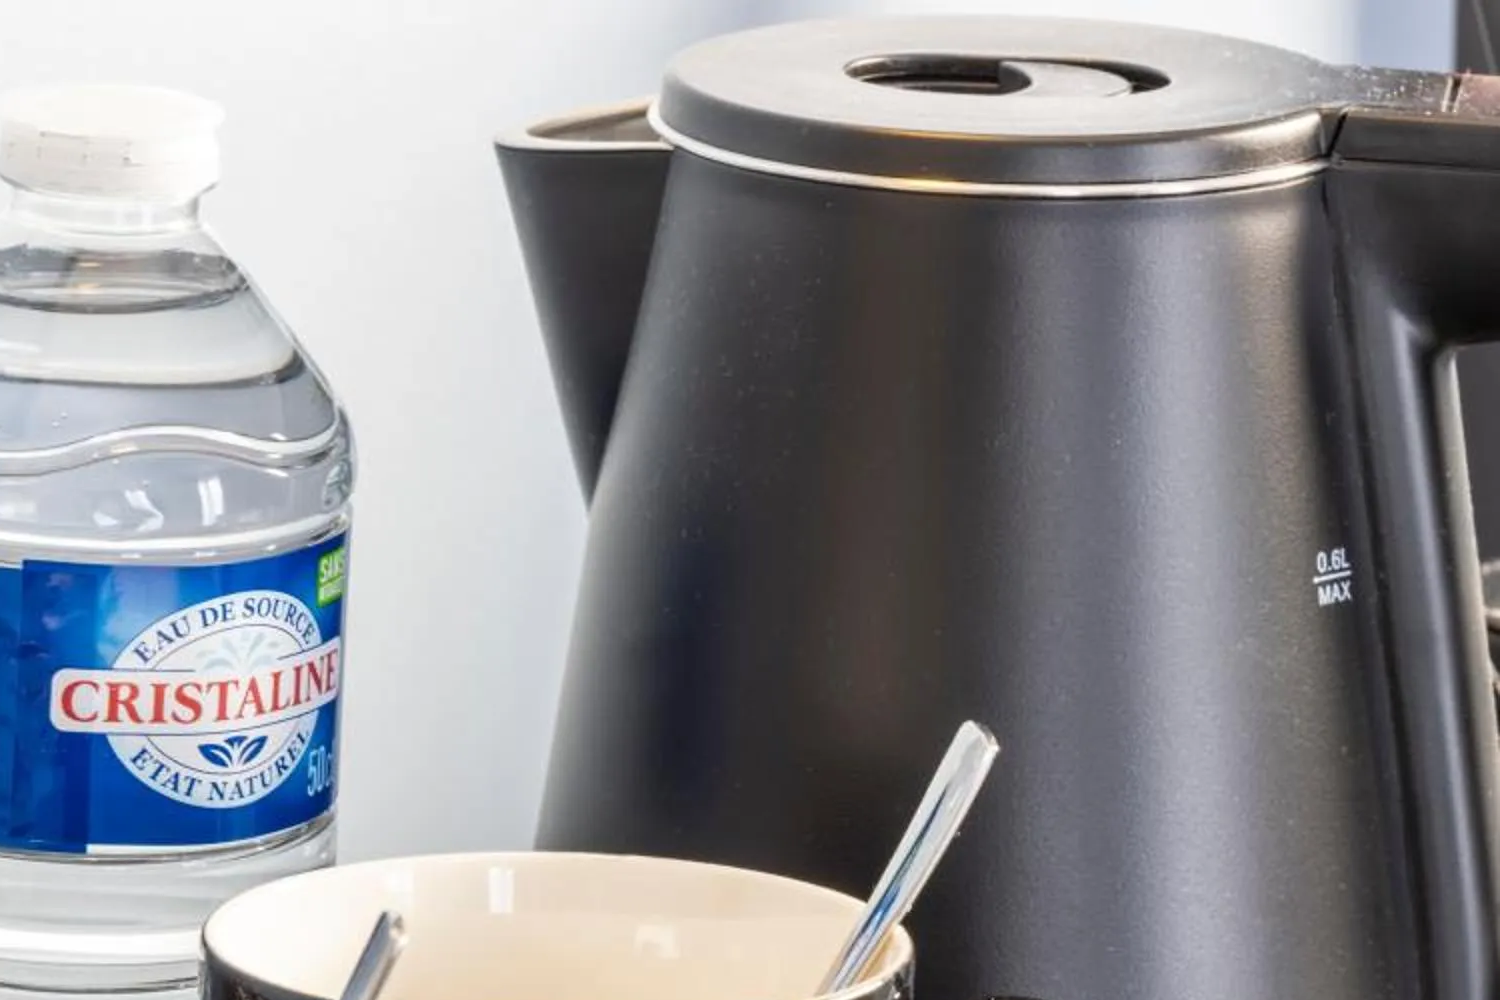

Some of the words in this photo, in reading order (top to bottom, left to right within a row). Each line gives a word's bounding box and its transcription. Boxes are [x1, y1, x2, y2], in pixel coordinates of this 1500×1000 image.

[1316, 548, 1350, 573] 0.6L
[1317, 581, 1351, 606] MAX
[133, 616, 192, 664] EAU
[200, 601, 236, 628] DE
[241, 597, 317, 644] SOURCE
[60, 648, 337, 724] CRISTALINE
[130, 746, 203, 797] ETAT
[207, 728, 309, 801] NATUREL
